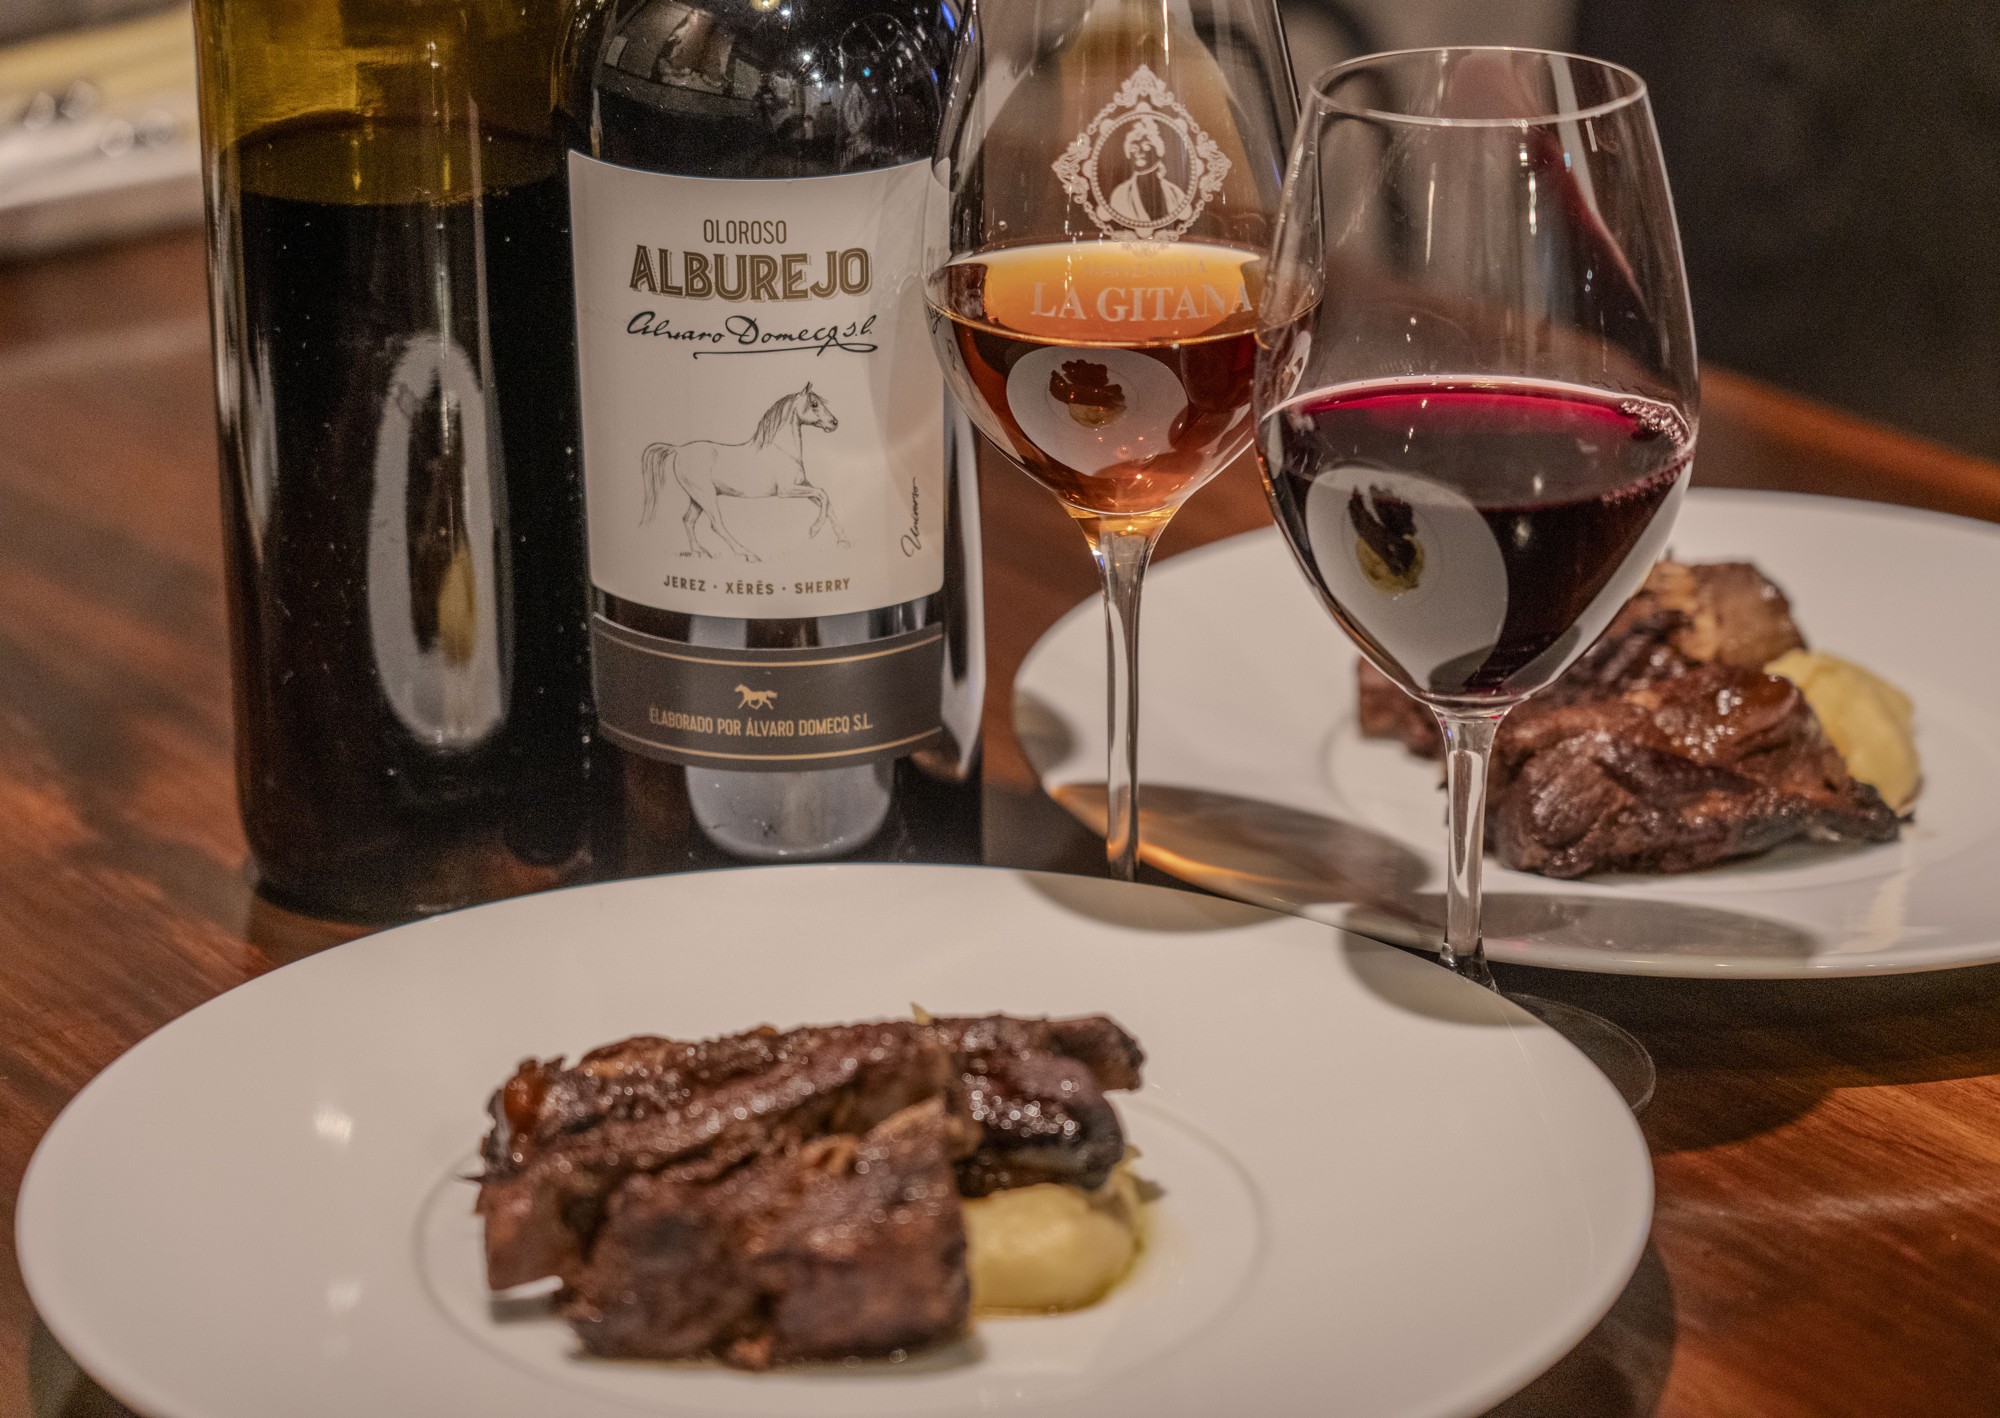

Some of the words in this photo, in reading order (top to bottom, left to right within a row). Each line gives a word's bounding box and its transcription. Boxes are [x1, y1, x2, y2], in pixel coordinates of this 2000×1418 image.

[703, 219, 788, 245] OLOROSO
[629, 244, 873, 302] ALBUREJO
[1030, 281, 1087, 320] LA
[1096, 282, 1254, 323] GITANA
[663, 575, 706, 592] JEREZ
[794, 578, 851, 595] SHERRY
[649, 707, 713, 735] ELABORADO
[717, 718, 742, 737] POR
[745, 716, 795, 738] ÁLVARO
[798, 716, 850, 736] DOMECQ
